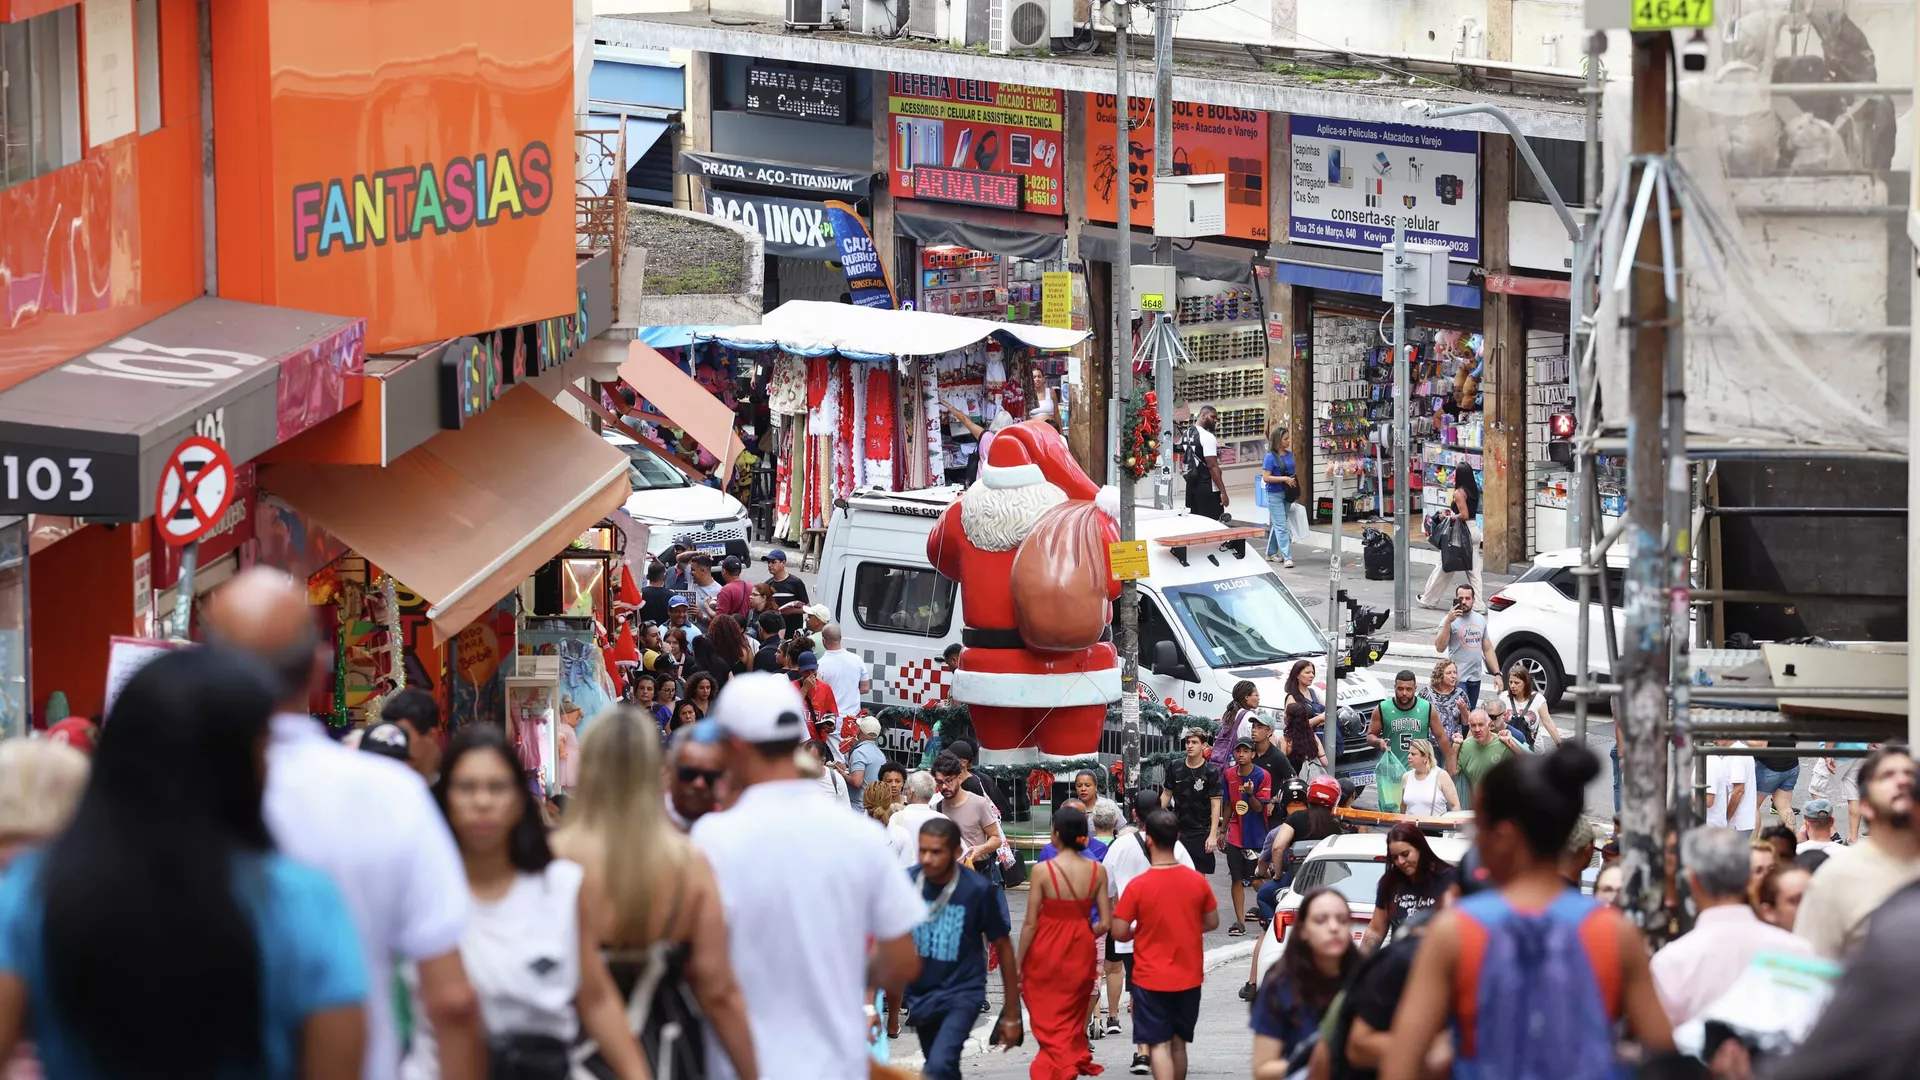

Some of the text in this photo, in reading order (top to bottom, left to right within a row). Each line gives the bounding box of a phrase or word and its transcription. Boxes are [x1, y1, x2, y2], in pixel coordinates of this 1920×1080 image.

[1639, 0, 1705, 21] 4647
[750, 70, 842, 98] PRATA e AÇO
[956, 77, 993, 102] CELL
[778, 94, 840, 116] Conjuntos
[995, 93, 1057, 112] ATACADO E VAREJO
[900, 101, 939, 116] ACESSÓRIOS
[947, 106, 976, 120] CELULAR
[977, 110, 982, 121] E
[982, 111, 1024, 126] ASSISTÊNCIA
[1197, 105, 1204, 118] e
[1208, 104, 1257, 123] BOLSAS
[1195, 121, 1225, 135] Atacado
[1227, 127, 1232, 135] e
[1234, 125, 1258, 140] Varejo
[1316, 123, 1347, 137] Aplica-se
[1383, 130, 1414, 144] Atacados
[1415, 136, 1420, 144] e
[1421, 135, 1442, 149] Varejo
[702, 162, 746, 179] PRATA
[756, 168, 853, 192] AÇO-TITANIUM
[293, 141, 553, 261] FANTASIAS
[1307, 192, 1320, 204] Som
[763, 203, 826, 248] INOX
[1332, 208, 1397, 227] conserta-se
[1251, 227, 1266, 237] 644
[1295, 221, 1308, 233] Rua
[1308, 222, 1316, 234] 25
[1316, 224, 1324, 235] de
[1325, 225, 1345, 239] Março,
[1345, 227, 1357, 239] 640
[1364, 230, 1387, 243] Kevin
[1142, 299, 1163, 309] 4648
[61, 337, 268, 388] 103
[513, 325, 526, 381] &
[196, 407, 226, 450] 103
[3, 456, 94, 501] 103
[892, 505, 920, 515] BASE
[1213, 579, 1252, 592] POLÍCIA
[457, 627, 483, 642] TUDO
[460, 646, 493, 669] Bebê
[1197, 690, 1214, 703] 190
[1337, 688, 1369, 701] OLÍCIA
[1391, 717, 1421, 733] BOSTON
[878, 731, 925, 753] OLÍCI
[1400, 733, 1413, 752] 5
